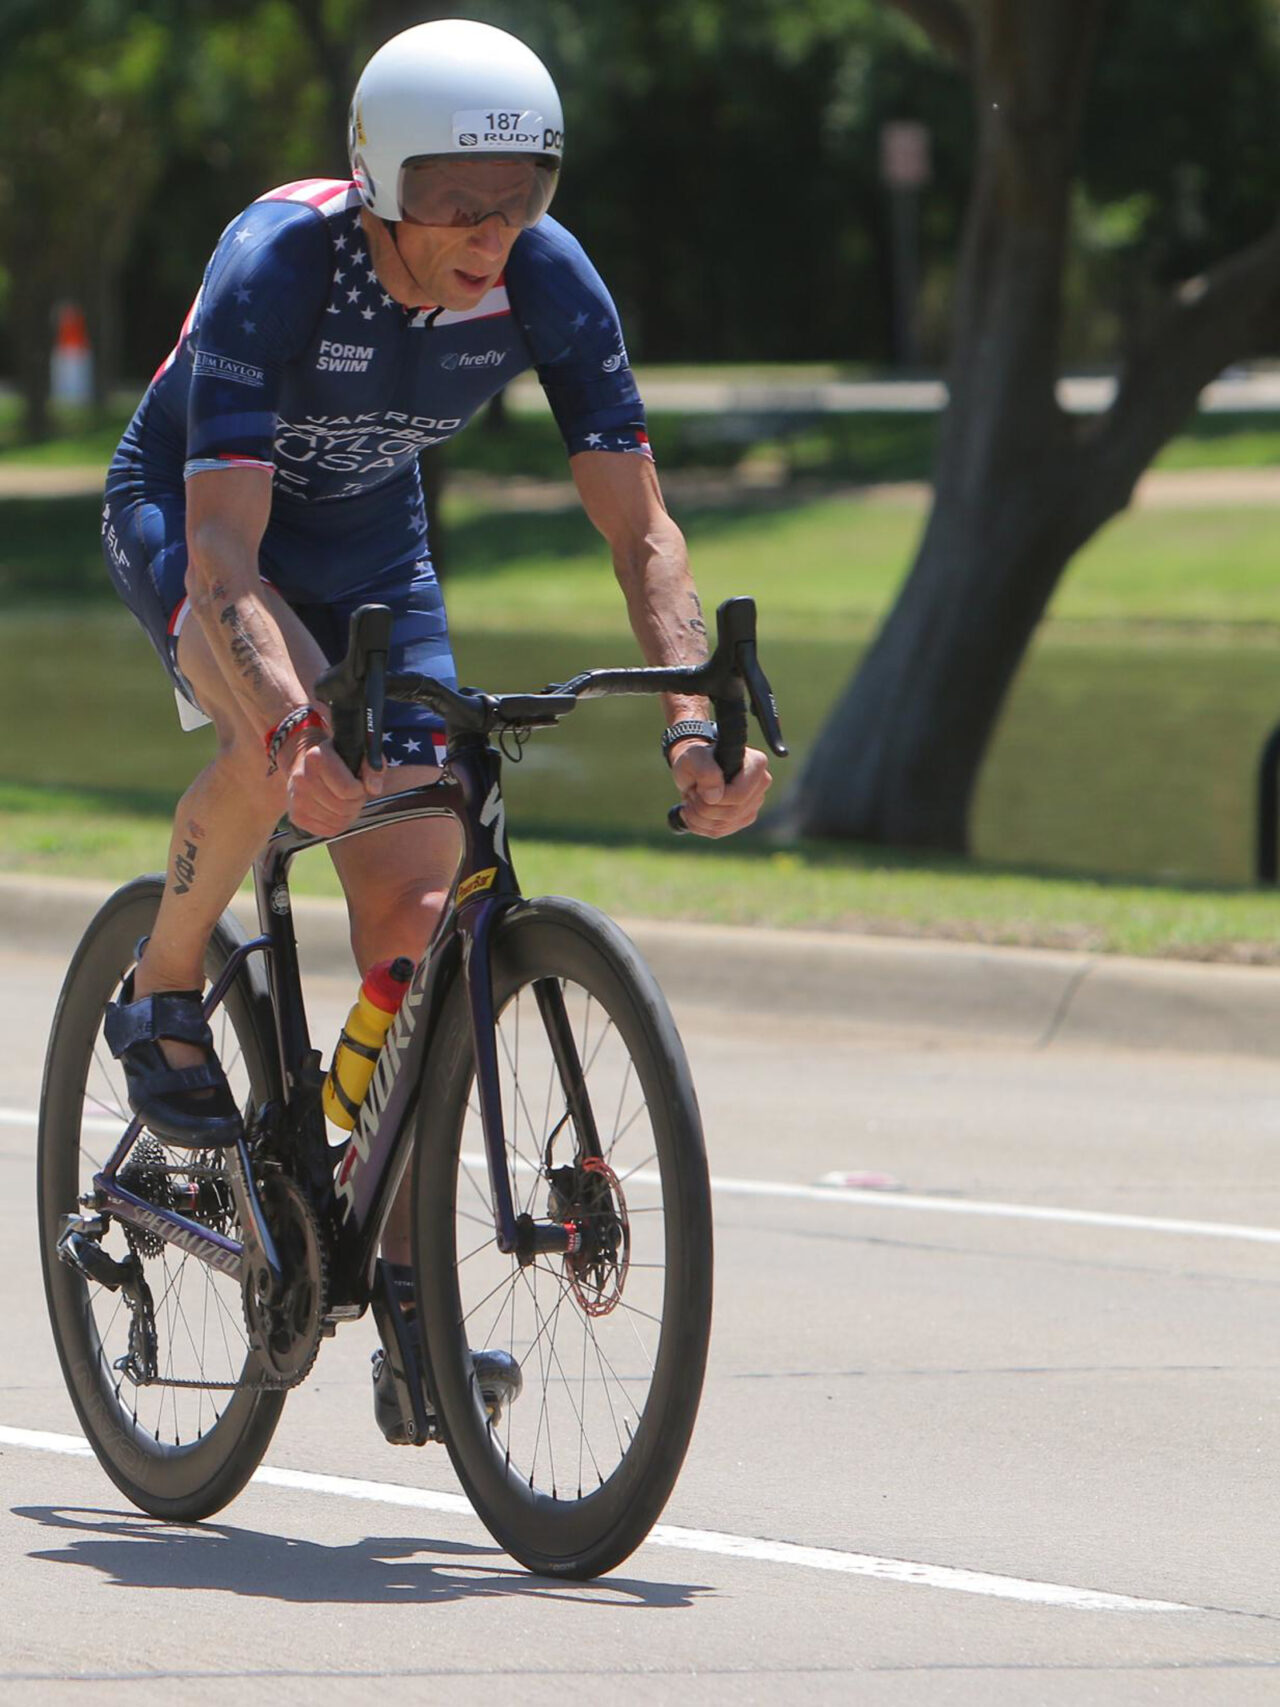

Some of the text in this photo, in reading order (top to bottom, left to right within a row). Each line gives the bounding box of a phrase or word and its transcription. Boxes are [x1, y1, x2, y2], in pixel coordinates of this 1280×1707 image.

[485, 113, 521, 130] 187
[483, 133, 540, 143] RUDY
[320, 339, 374, 360] FORM
[458, 350, 506, 367] firefly
[219, 359, 265, 380] TAYLOR
[316, 356, 369, 373] SWIM
[305, 410, 462, 430] JAKROO
[274, 438, 395, 473] USA
[134, 1205, 242, 1272] SPECIALIZED
